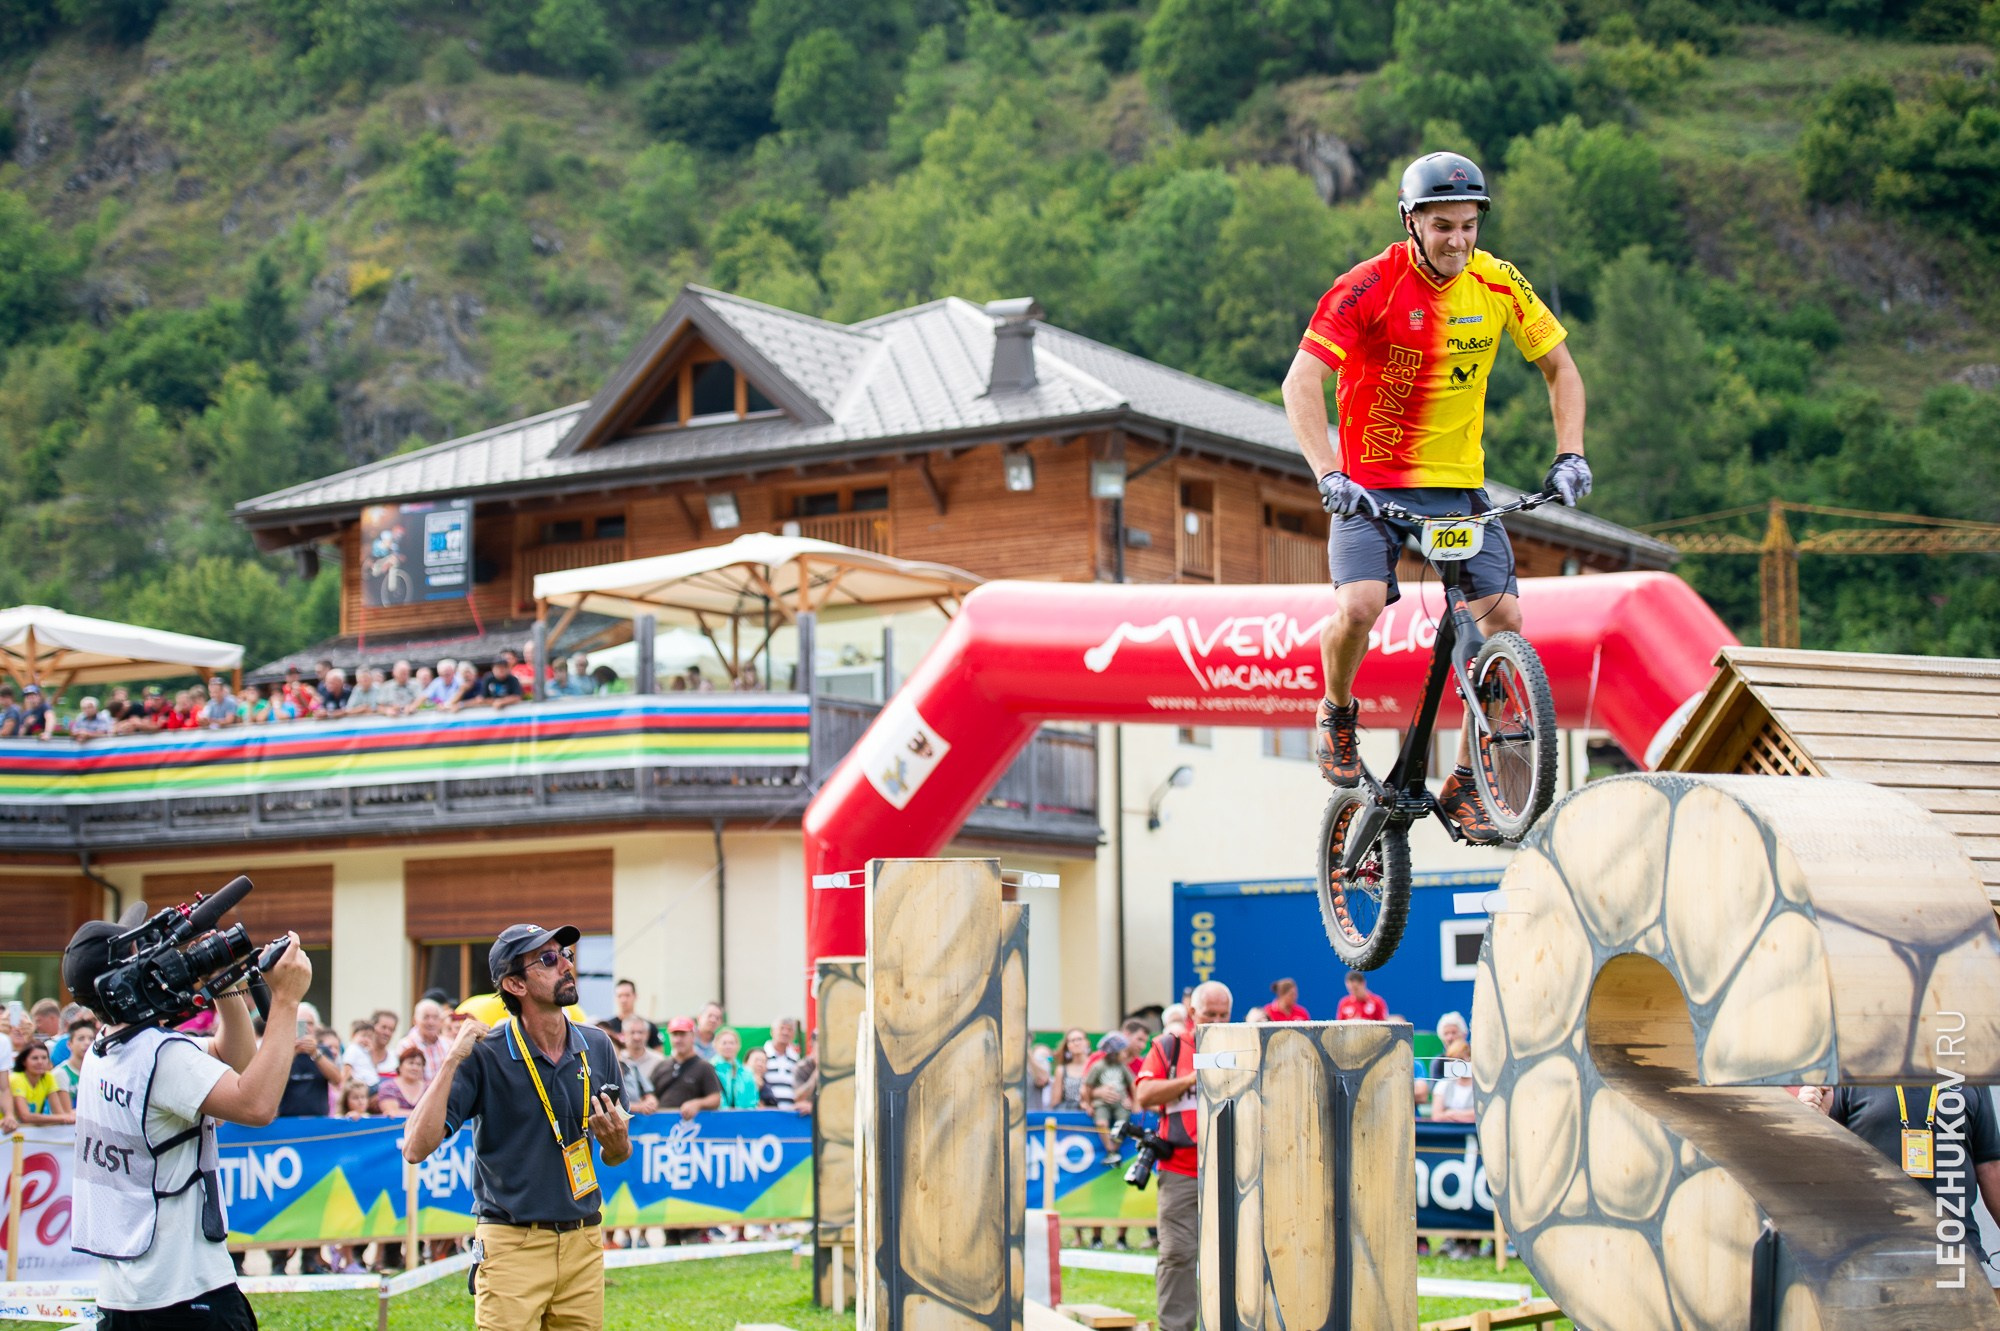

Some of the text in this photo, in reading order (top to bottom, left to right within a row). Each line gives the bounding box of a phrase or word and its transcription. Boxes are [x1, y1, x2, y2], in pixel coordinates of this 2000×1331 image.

[1337, 271, 1381, 316] mu&cia
[1446, 336, 1494, 351] mu&cia
[1360, 344, 1423, 463] ESPAÑA
[1438, 530, 1468, 547] 104
[1187, 609, 1437, 660] VERMLIO
[1204, 665, 1318, 690] VACANZE
[639, 1133, 783, 1190] TRENTINO
